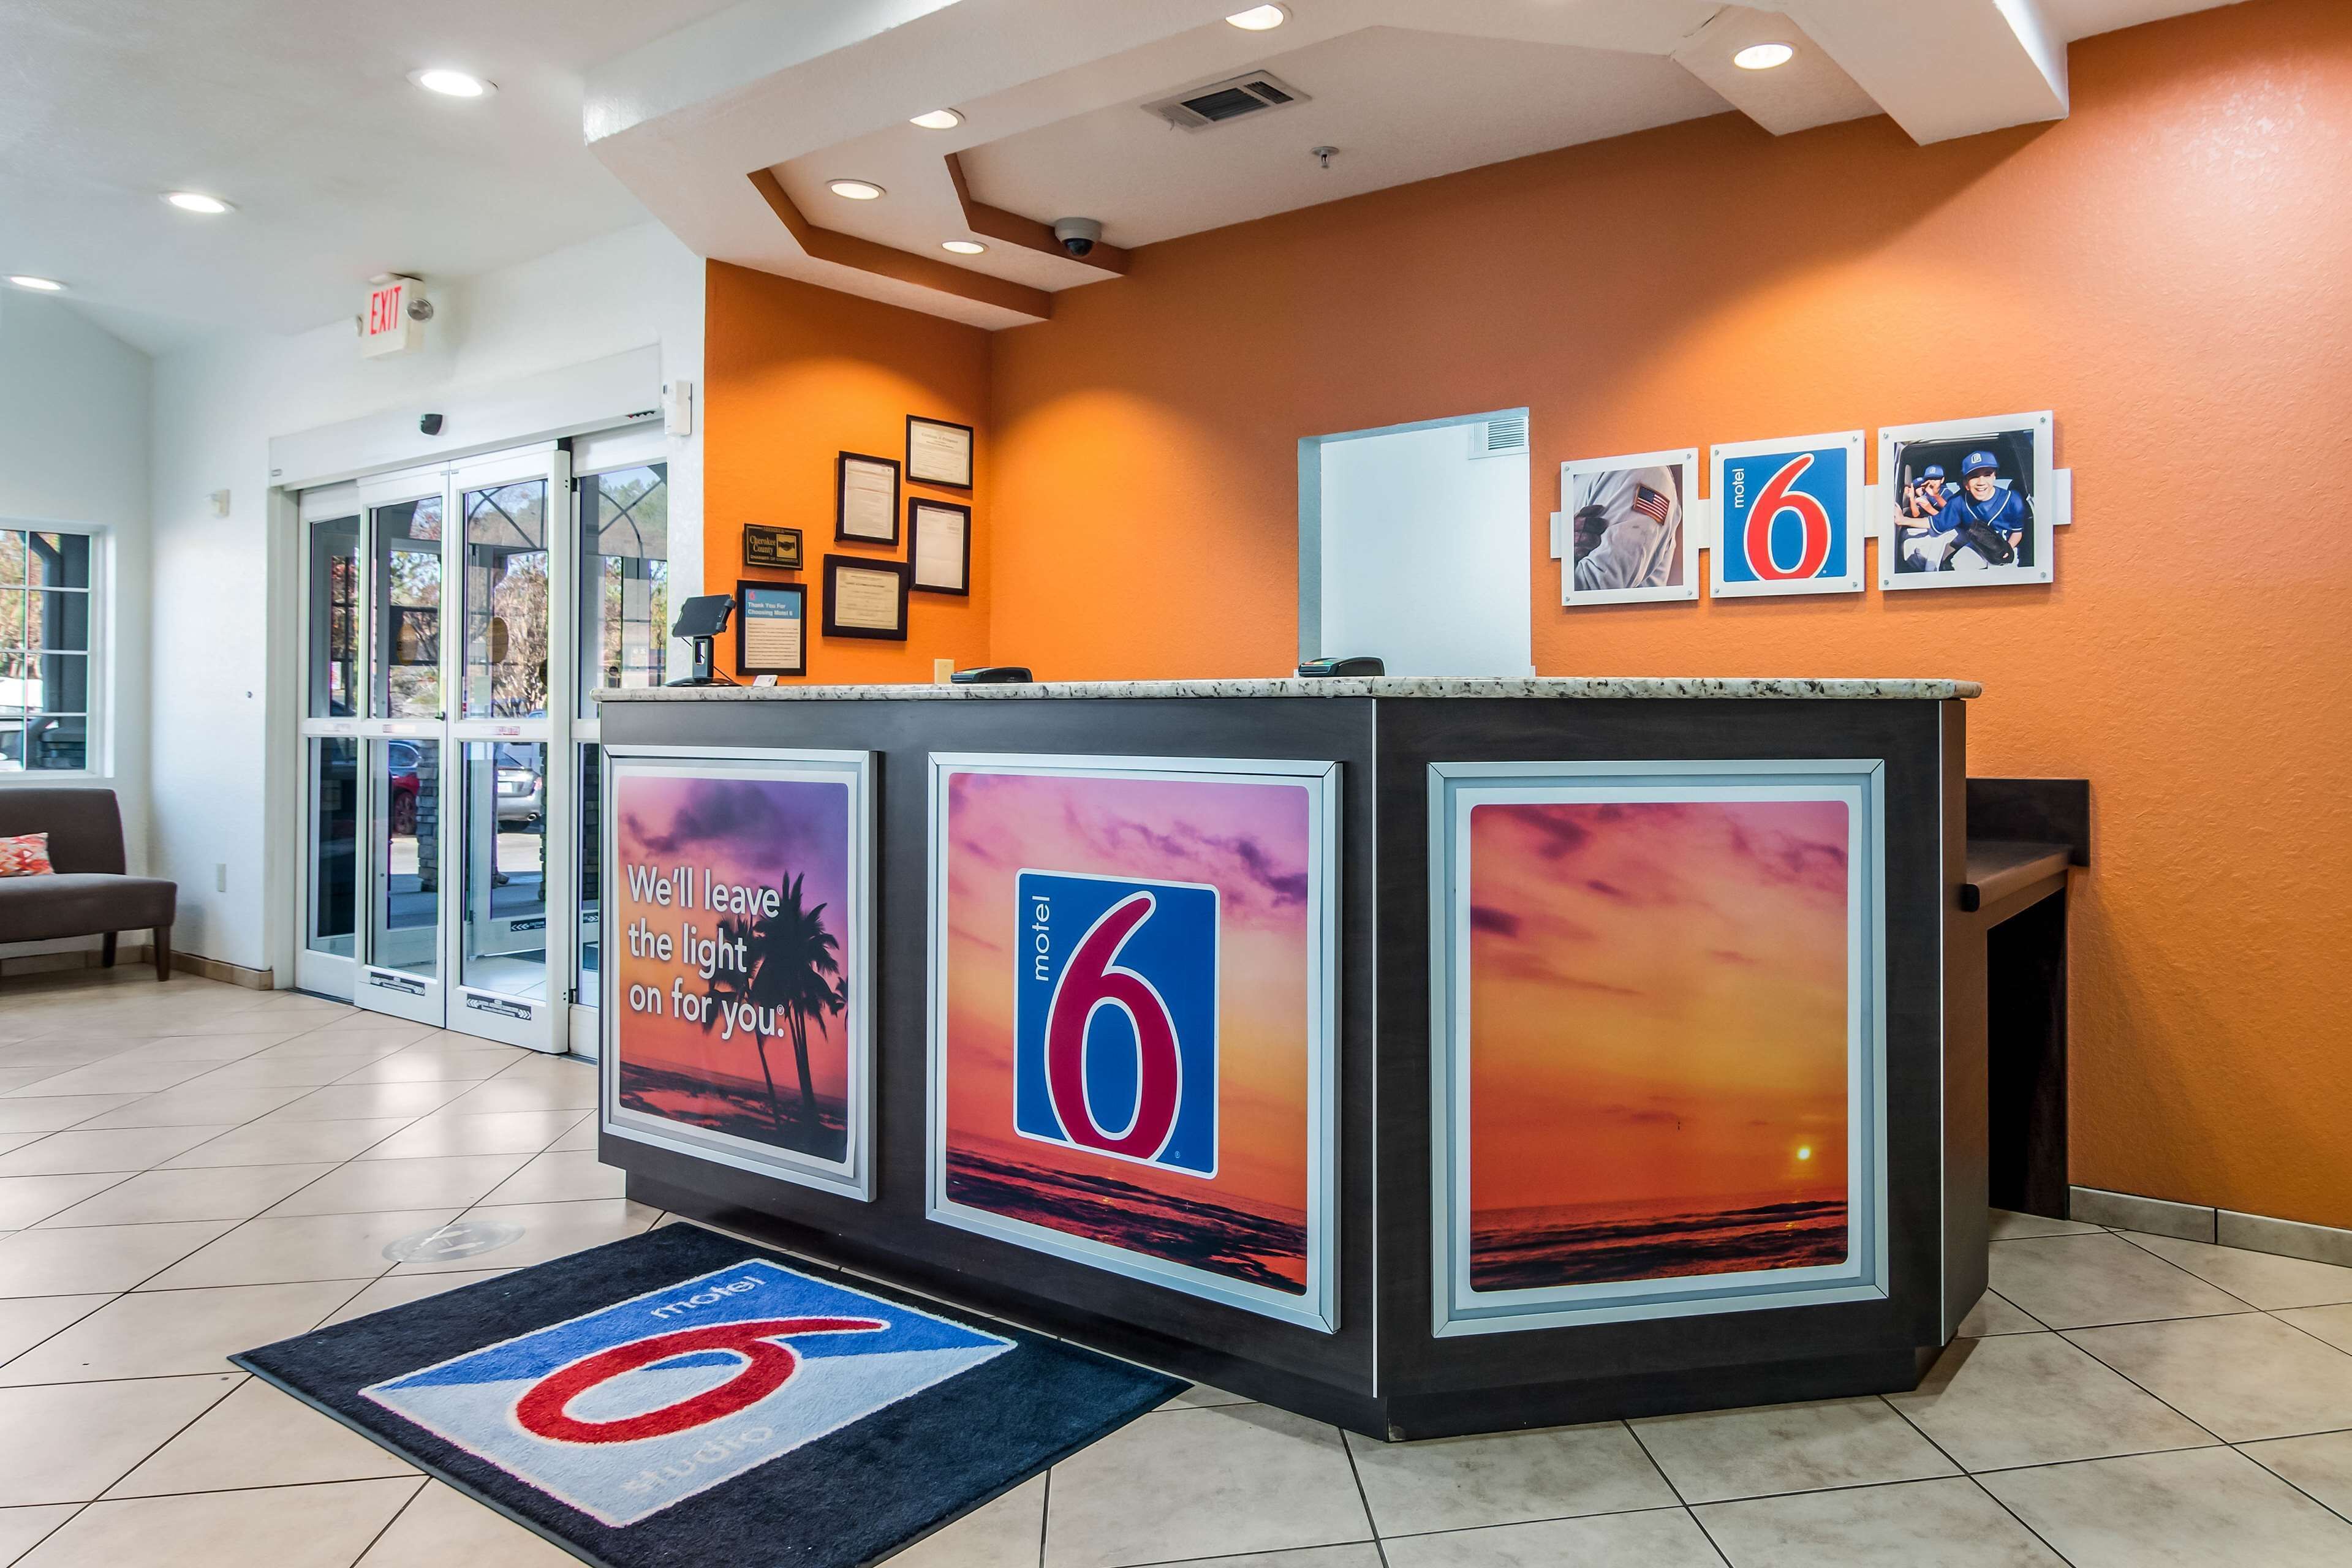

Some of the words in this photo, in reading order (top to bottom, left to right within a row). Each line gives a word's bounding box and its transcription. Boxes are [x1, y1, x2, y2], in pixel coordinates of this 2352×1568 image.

[370, 285, 403, 335] EXIT
[1732, 468, 1744, 508] motel
[750, 535, 776, 546] Cherokee
[1744, 453, 1831, 581] 6
[753, 543, 774, 556] County
[627, 864, 694, 908] We'll
[705, 869, 781, 918] leave
[628, 918, 673, 961] the
[683, 922, 747, 979] light
[1032, 895, 1050, 981] motel
[629, 984, 662, 1014] on
[671, 978, 713, 1023] for
[1044, 890, 1182, 1163] 6
[650, 1276, 766, 1320] motel
[506, 1316, 891, 1448] 6
[620, 1427, 774, 1493] studio
